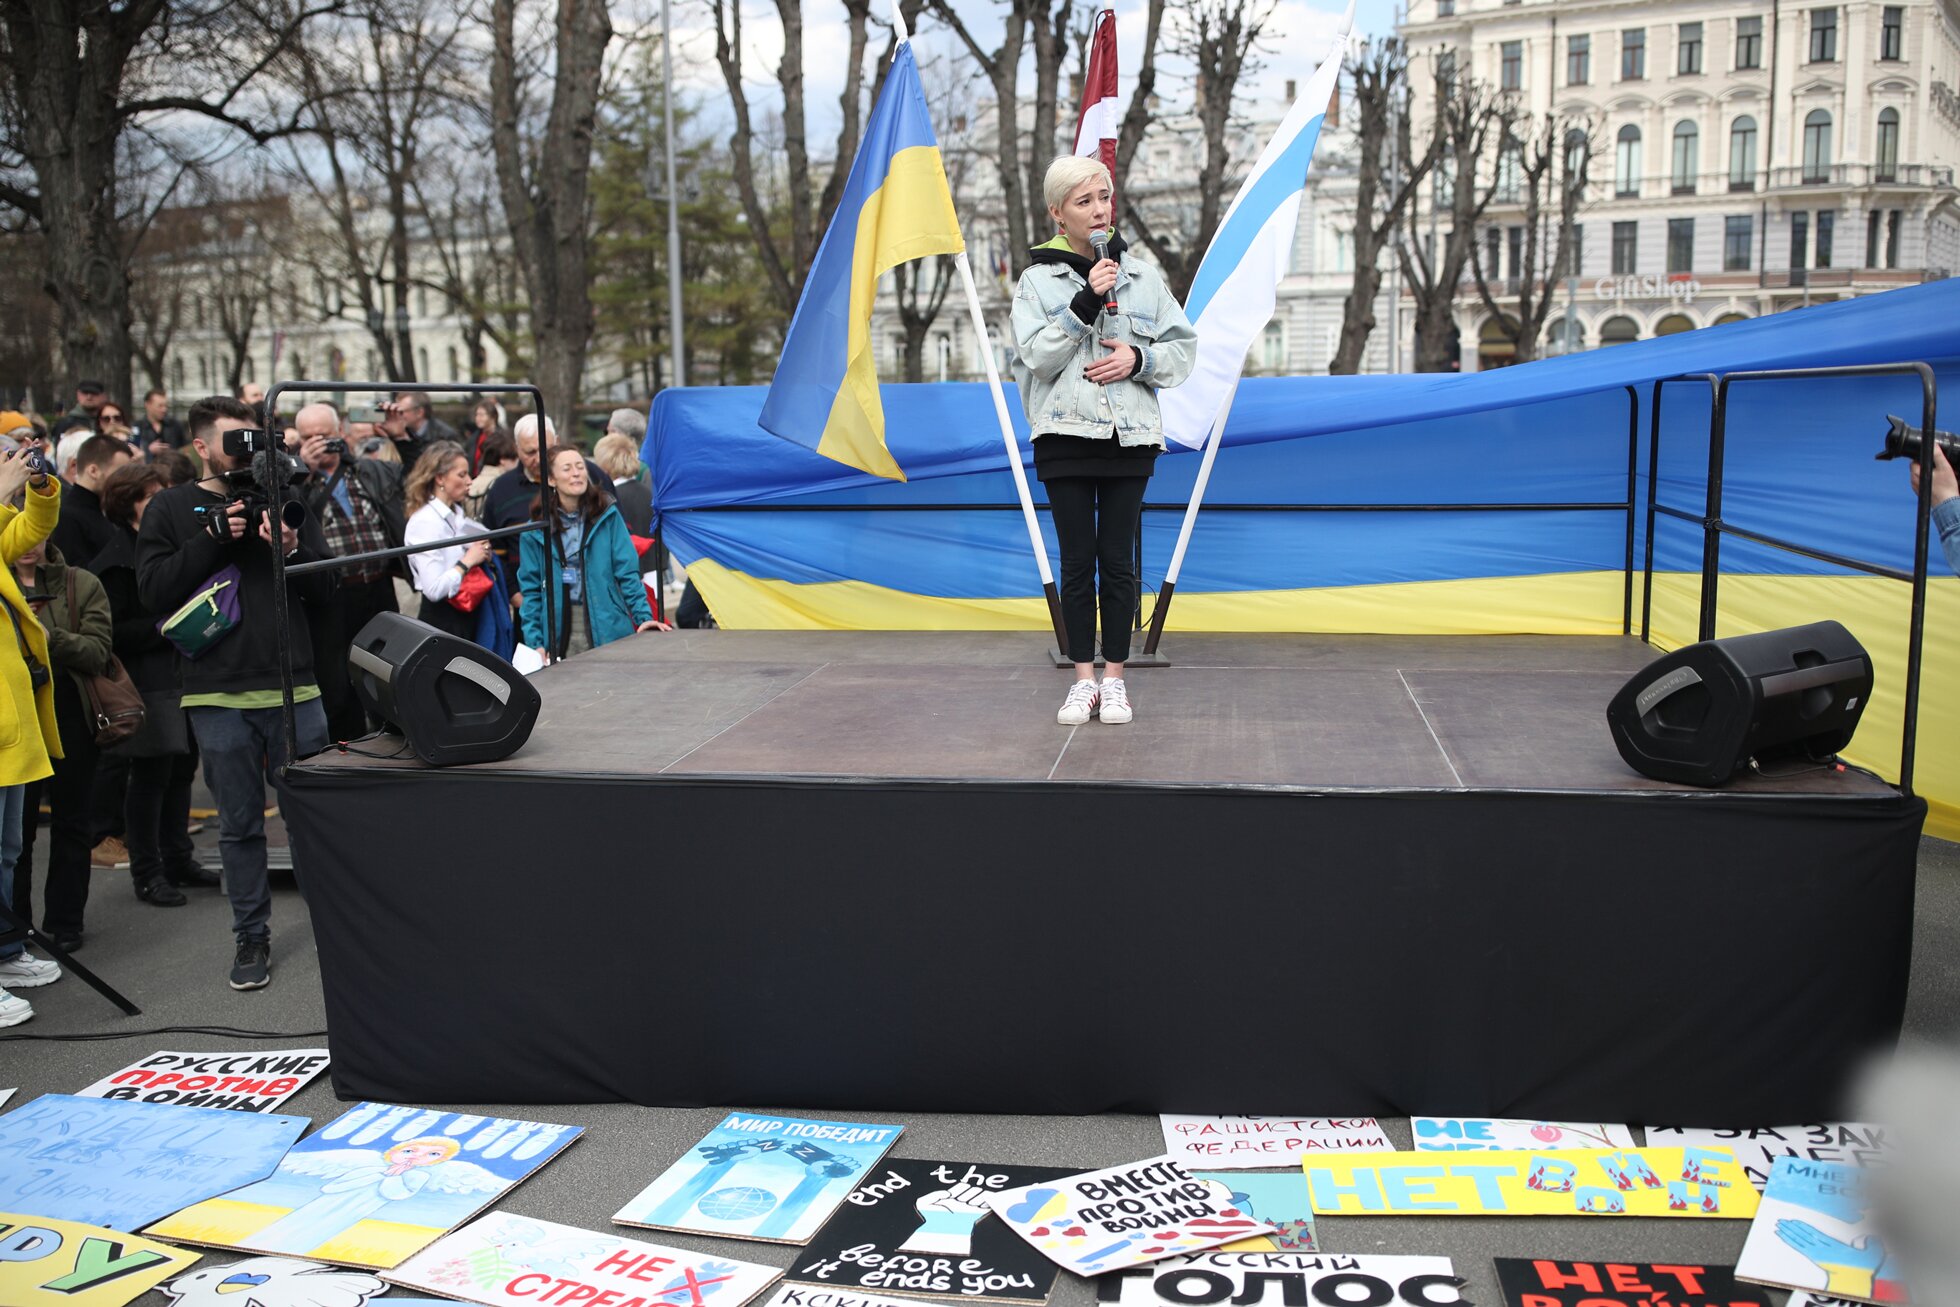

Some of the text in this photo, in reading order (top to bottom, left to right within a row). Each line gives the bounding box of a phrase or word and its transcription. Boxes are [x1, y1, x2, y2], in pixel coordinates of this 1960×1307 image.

[140, 1055, 328, 1075] РУССКИЕ
[110, 1070, 299, 1096] ПРОТИВ
[724, 1117, 894, 1145] МИР ПОБЕДИТ
[1186, 1137, 1384, 1155] ФЕДЕРАЦИИ
[847, 1165, 1009, 1207] end the
[1076, 1161, 1193, 1201] ВМЕСТЕ
[1309, 1165, 1518, 1210] НЕТ
[1077, 1182, 1211, 1223] ПРОТИВ
[1102, 1201, 1217, 1233] ВОЙНЫ
[594, 1250, 676, 1283] НЕ
[802, 1259, 1035, 1295] it ends you
[1532, 1260, 1705, 1294] НЕТ
[1099, 1268, 1475, 1307] ГОЛОС
